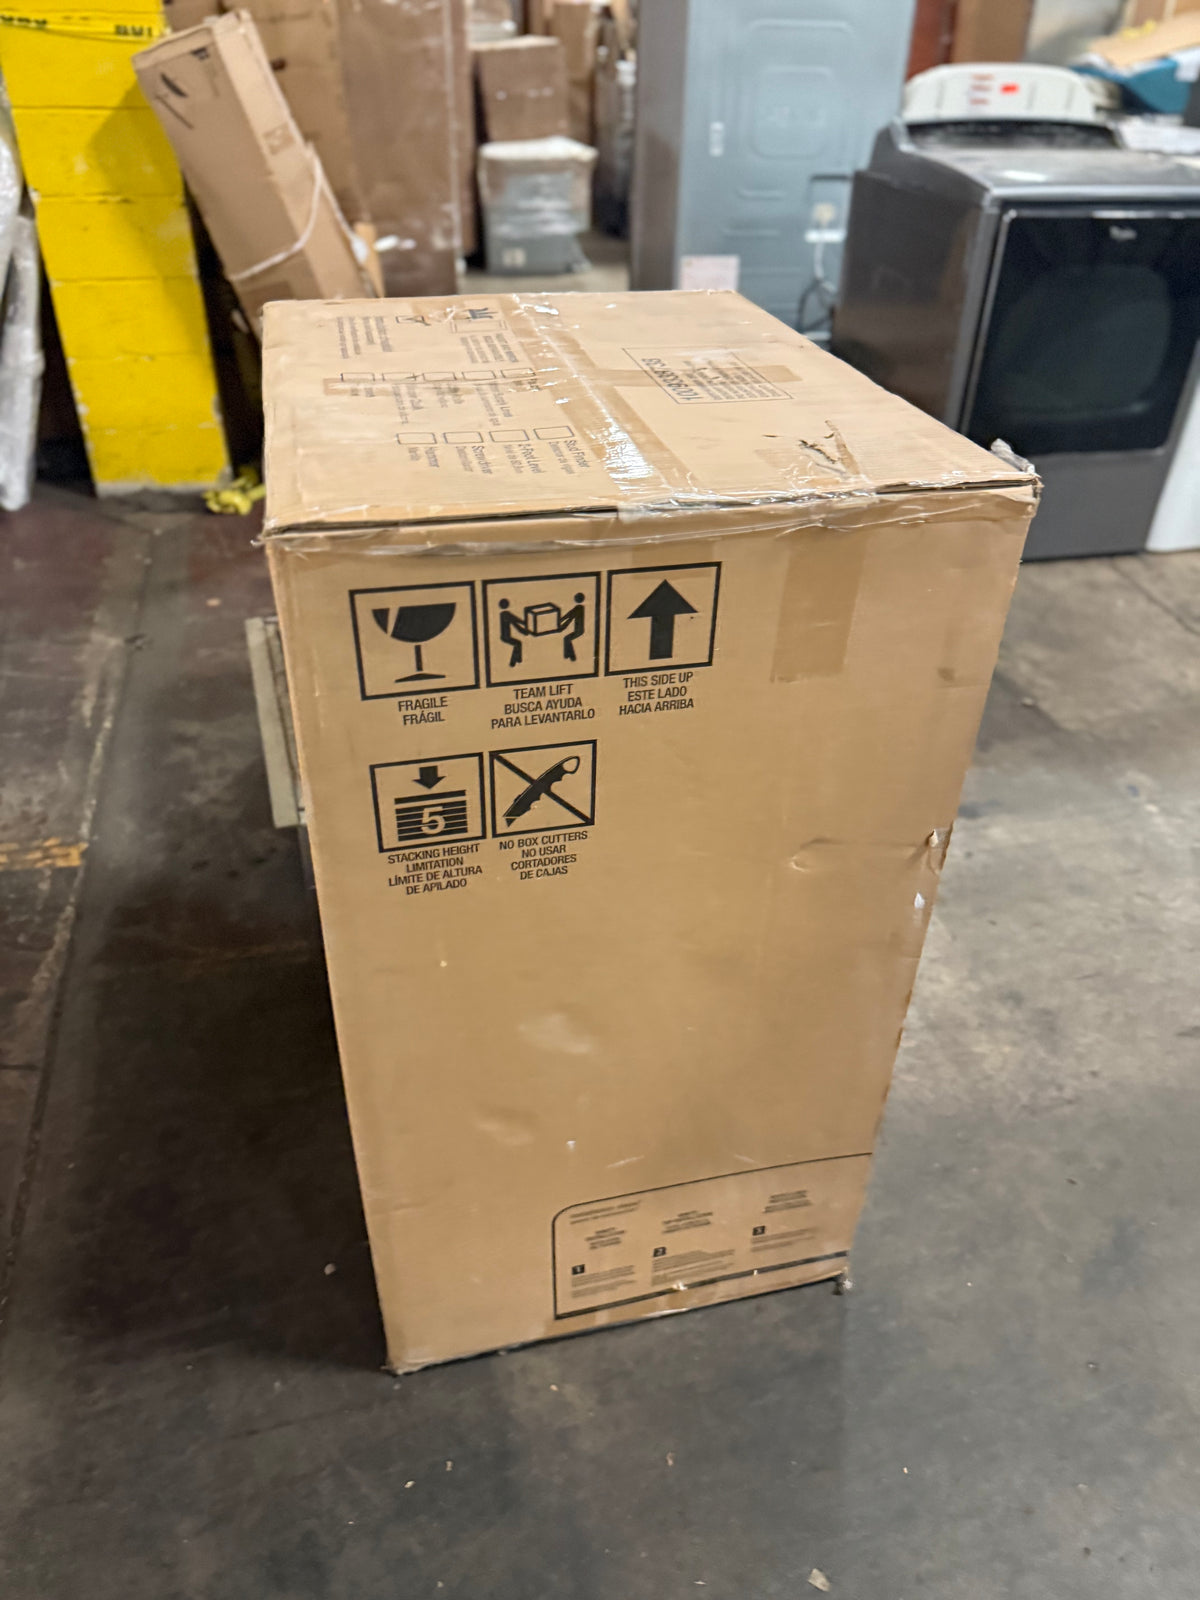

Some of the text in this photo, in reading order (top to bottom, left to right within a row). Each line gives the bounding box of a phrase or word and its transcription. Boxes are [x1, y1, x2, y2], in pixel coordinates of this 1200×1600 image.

[623, 671, 694, 688] THIS SIDE UP
[513, 683, 574, 699] TEAM LIFT
[627, 685, 687, 702] ESTE LADO
[398, 696, 449, 712] FRAGILE
[504, 696, 583, 715] BUSCA AYUDA
[619, 698, 694, 715] HACIA ARRIBA
[403, 711, 446, 726] FRÁGIL
[491, 708, 596, 729] PARA LEVANTARLO
[421, 805, 446, 835] 5
[499, 830, 588, 850] NO BOX CUTTERS
[387, 843, 480, 865] STACKING HEIGHT
[521, 844, 566, 858] NO USAR
[406, 856, 464, 873] LIMITATION
[510, 854, 577, 871] CORTADORES
[388, 865, 483, 887] LÍMITE DE ALTURA
[520, 866, 568, 880] DE CAJAS
[406, 878, 468, 895] DE APILADO
